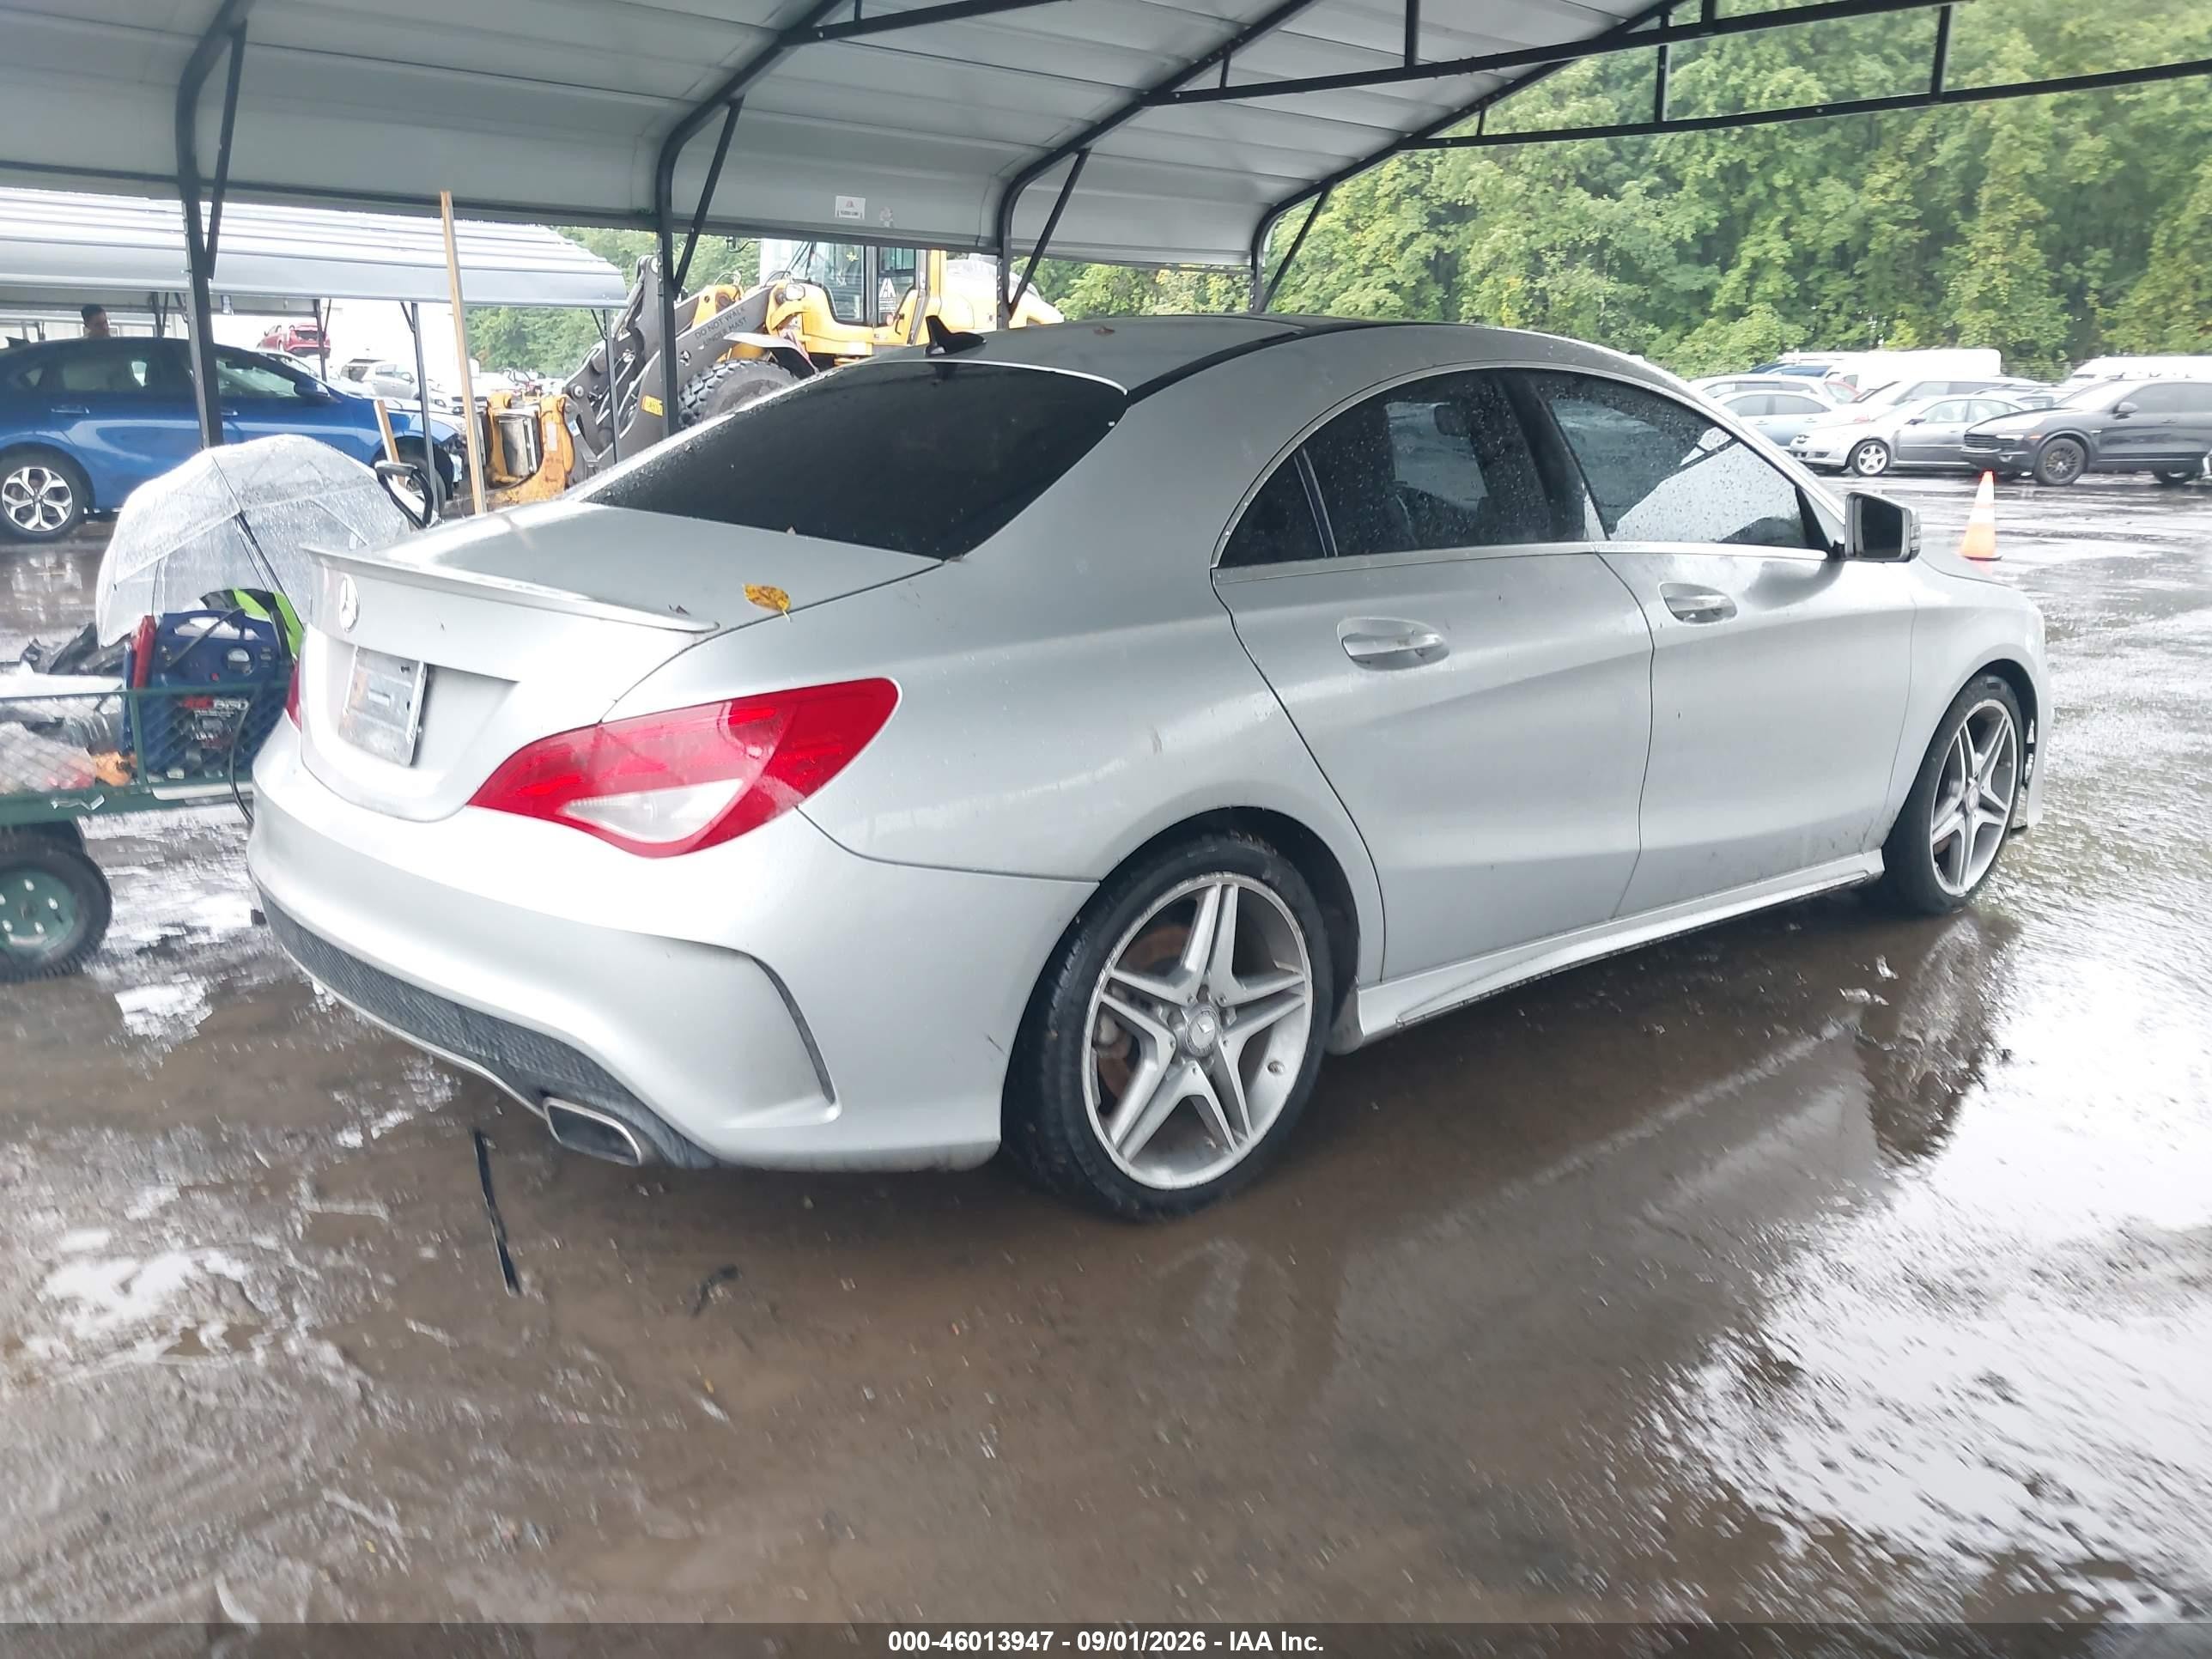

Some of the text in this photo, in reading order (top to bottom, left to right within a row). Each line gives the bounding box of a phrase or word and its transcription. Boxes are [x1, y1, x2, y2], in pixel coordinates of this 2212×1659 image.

[695, 307, 745, 339] DO NOT WALK
[729, 317, 747, 330] MAST
